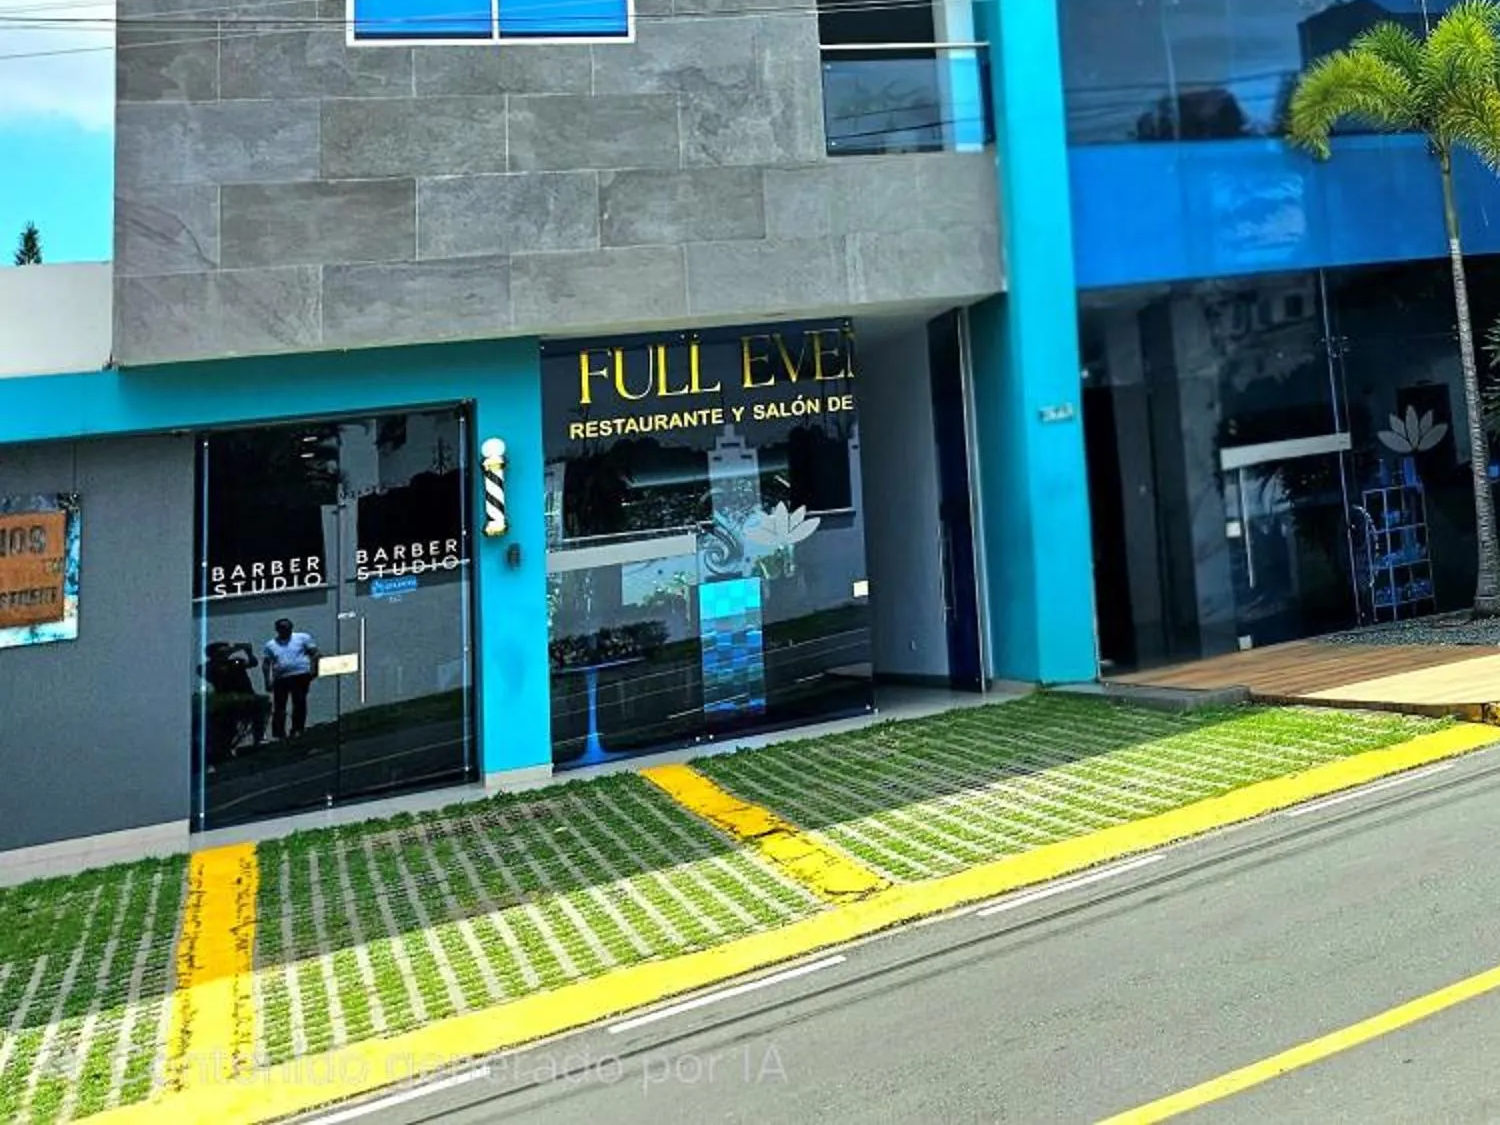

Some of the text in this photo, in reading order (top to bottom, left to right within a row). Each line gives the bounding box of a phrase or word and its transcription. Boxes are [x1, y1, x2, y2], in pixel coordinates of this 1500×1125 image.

[579, 343, 722, 405] FULL
[569, 394, 854, 440] RESTAURANTE Y SALÓN DE
[355, 538, 458, 564] BARBER
[211, 556, 320, 582] BARBER
[356, 554, 459, 581] STUDIO
[213, 572, 322, 599] STUDIO
